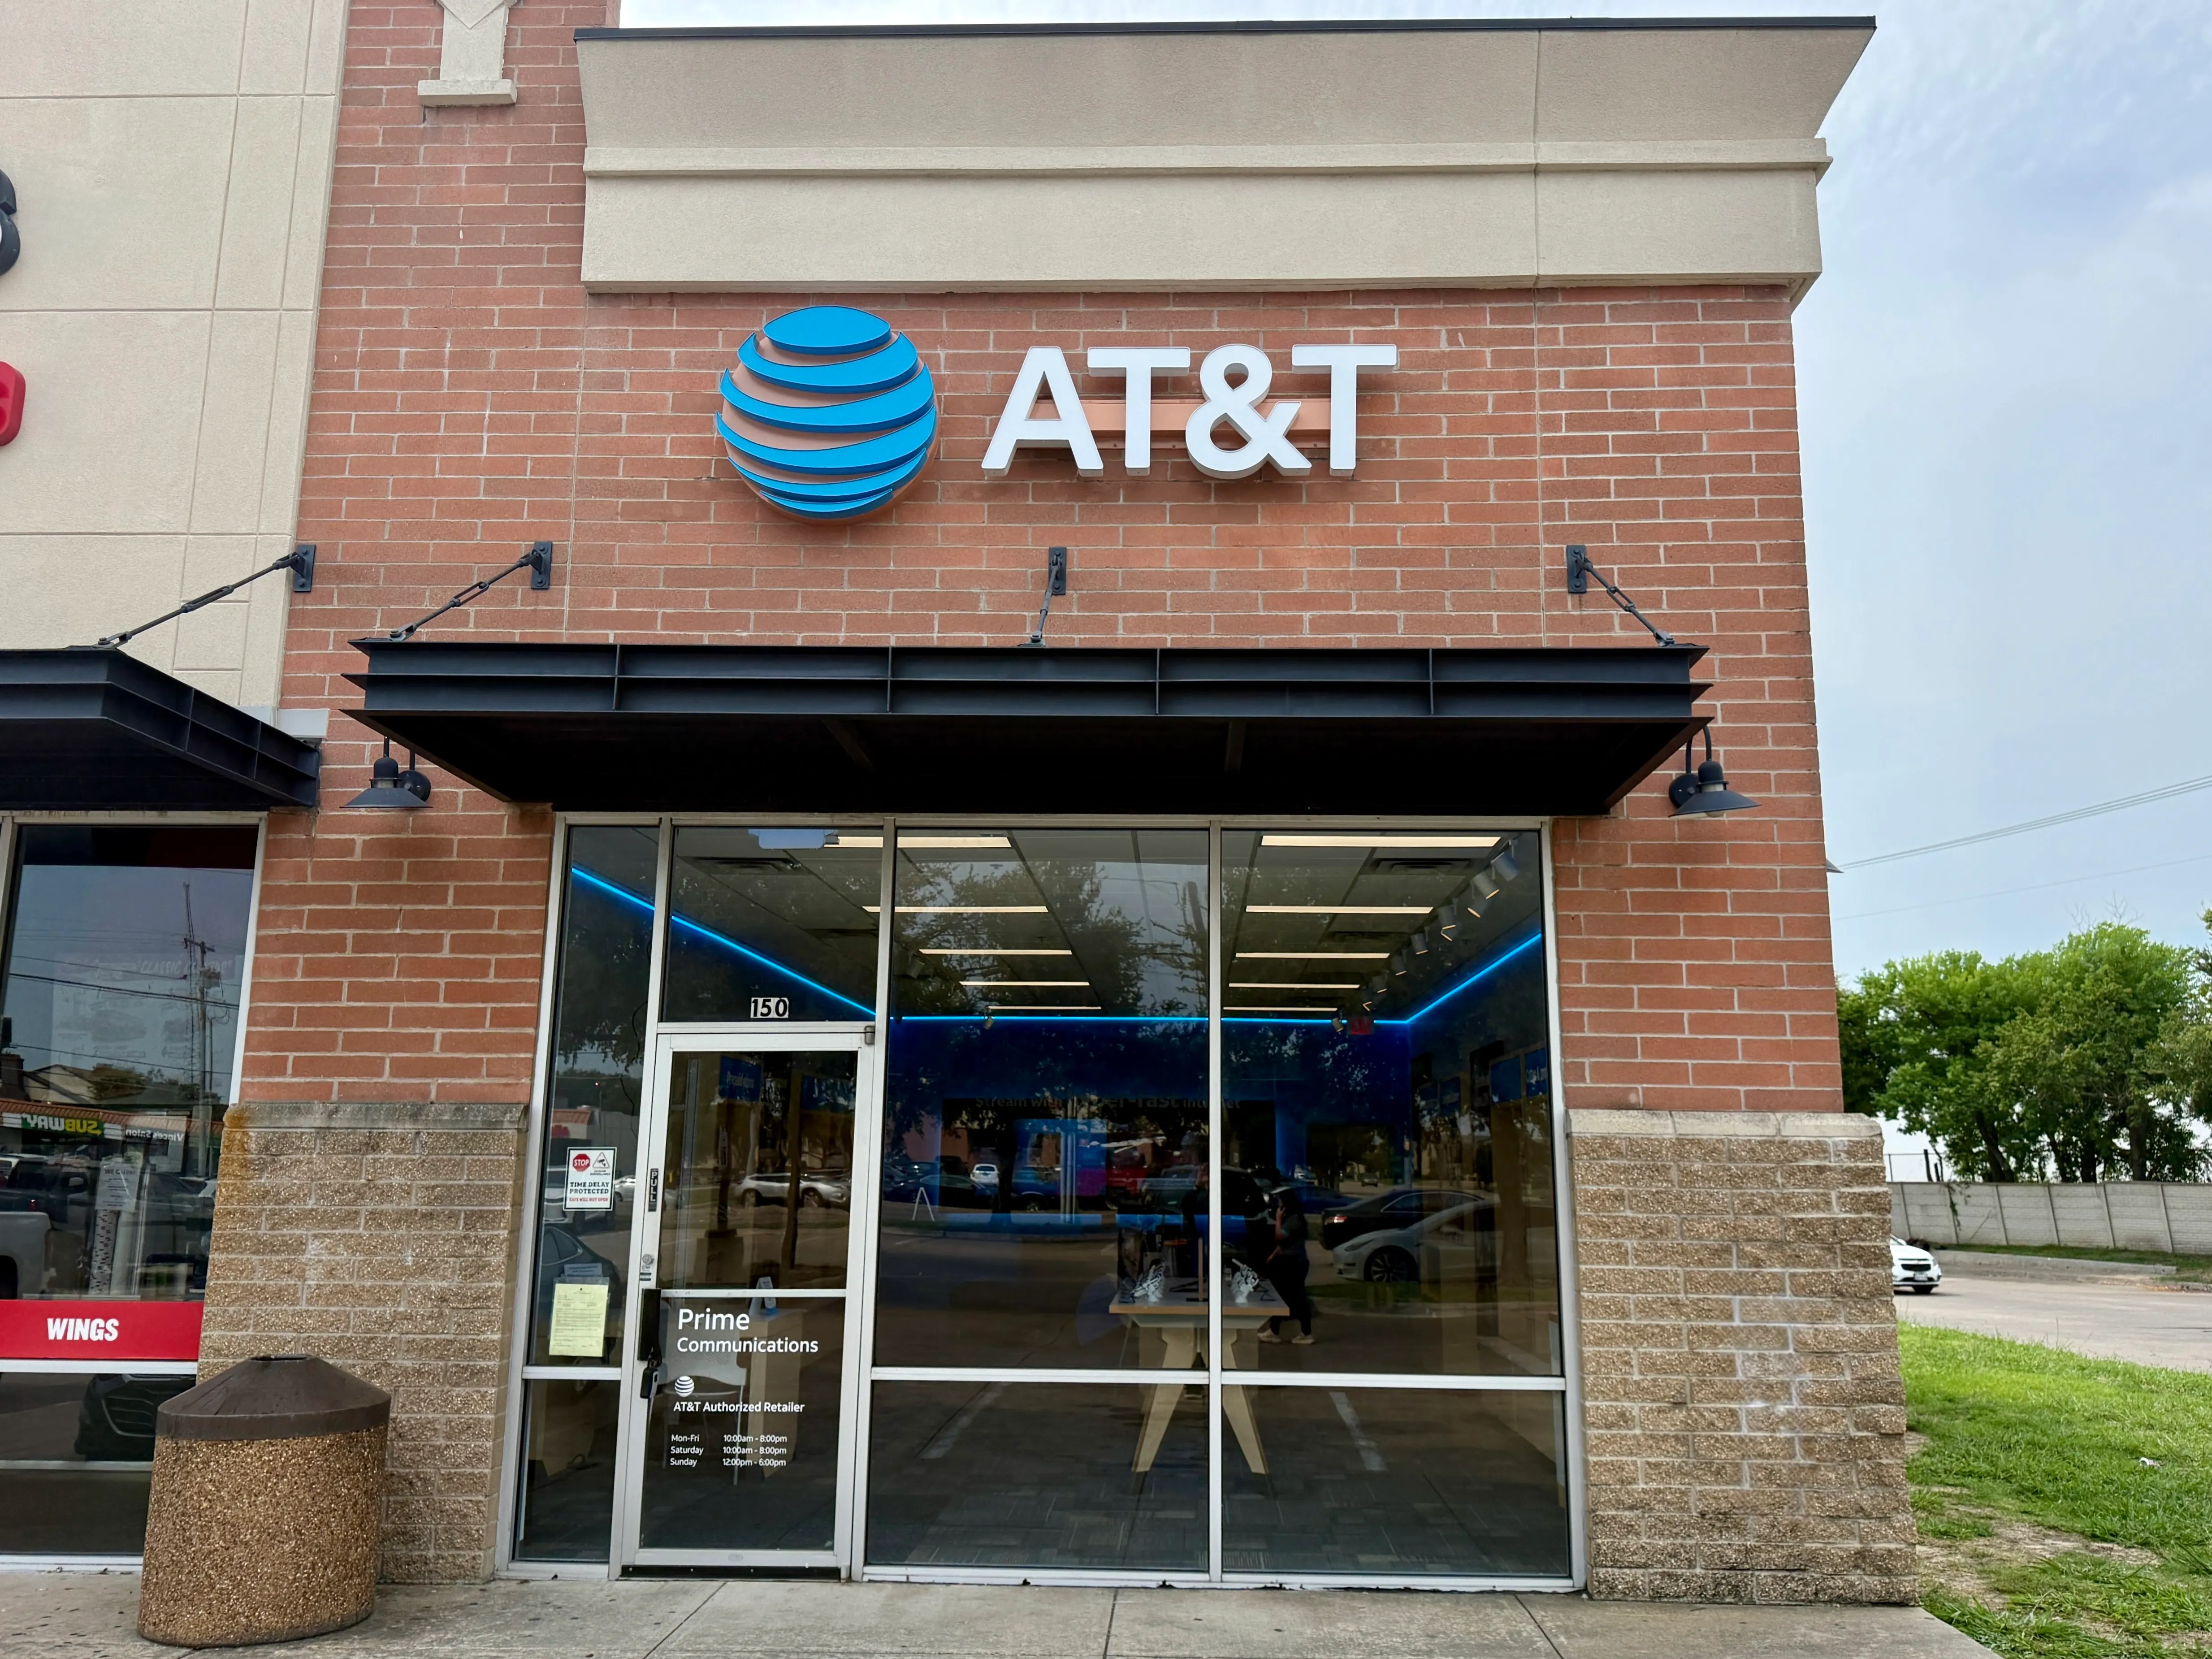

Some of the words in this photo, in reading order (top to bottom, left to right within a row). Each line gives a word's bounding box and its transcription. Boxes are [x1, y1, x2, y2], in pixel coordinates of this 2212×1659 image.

[981, 344, 1397, 478] AT&T
[752, 998, 788, 1017] 150
[975, 1096, 1026, 1108] Stream
[678, 1308, 750, 1330] Prime
[48, 1318, 119, 1341] WINGS
[677, 1337, 818, 1352] Communications
[673, 1402, 701, 1412] AT&T
[703, 1402, 761, 1412] Authorized
[764, 1402, 805, 1412] Retailer
[671, 1434, 700, 1442] Mon-Fri
[759, 1434, 787, 1443] 8:00pm
[671, 1446, 704, 1455] Saturday
[759, 1447, 787, 1455] 8:00pm
[670, 1458, 697, 1467] Sunday
[723, 1458, 753, 1467] 12:00pm
[759, 1458, 786, 1468] 6:00pm
